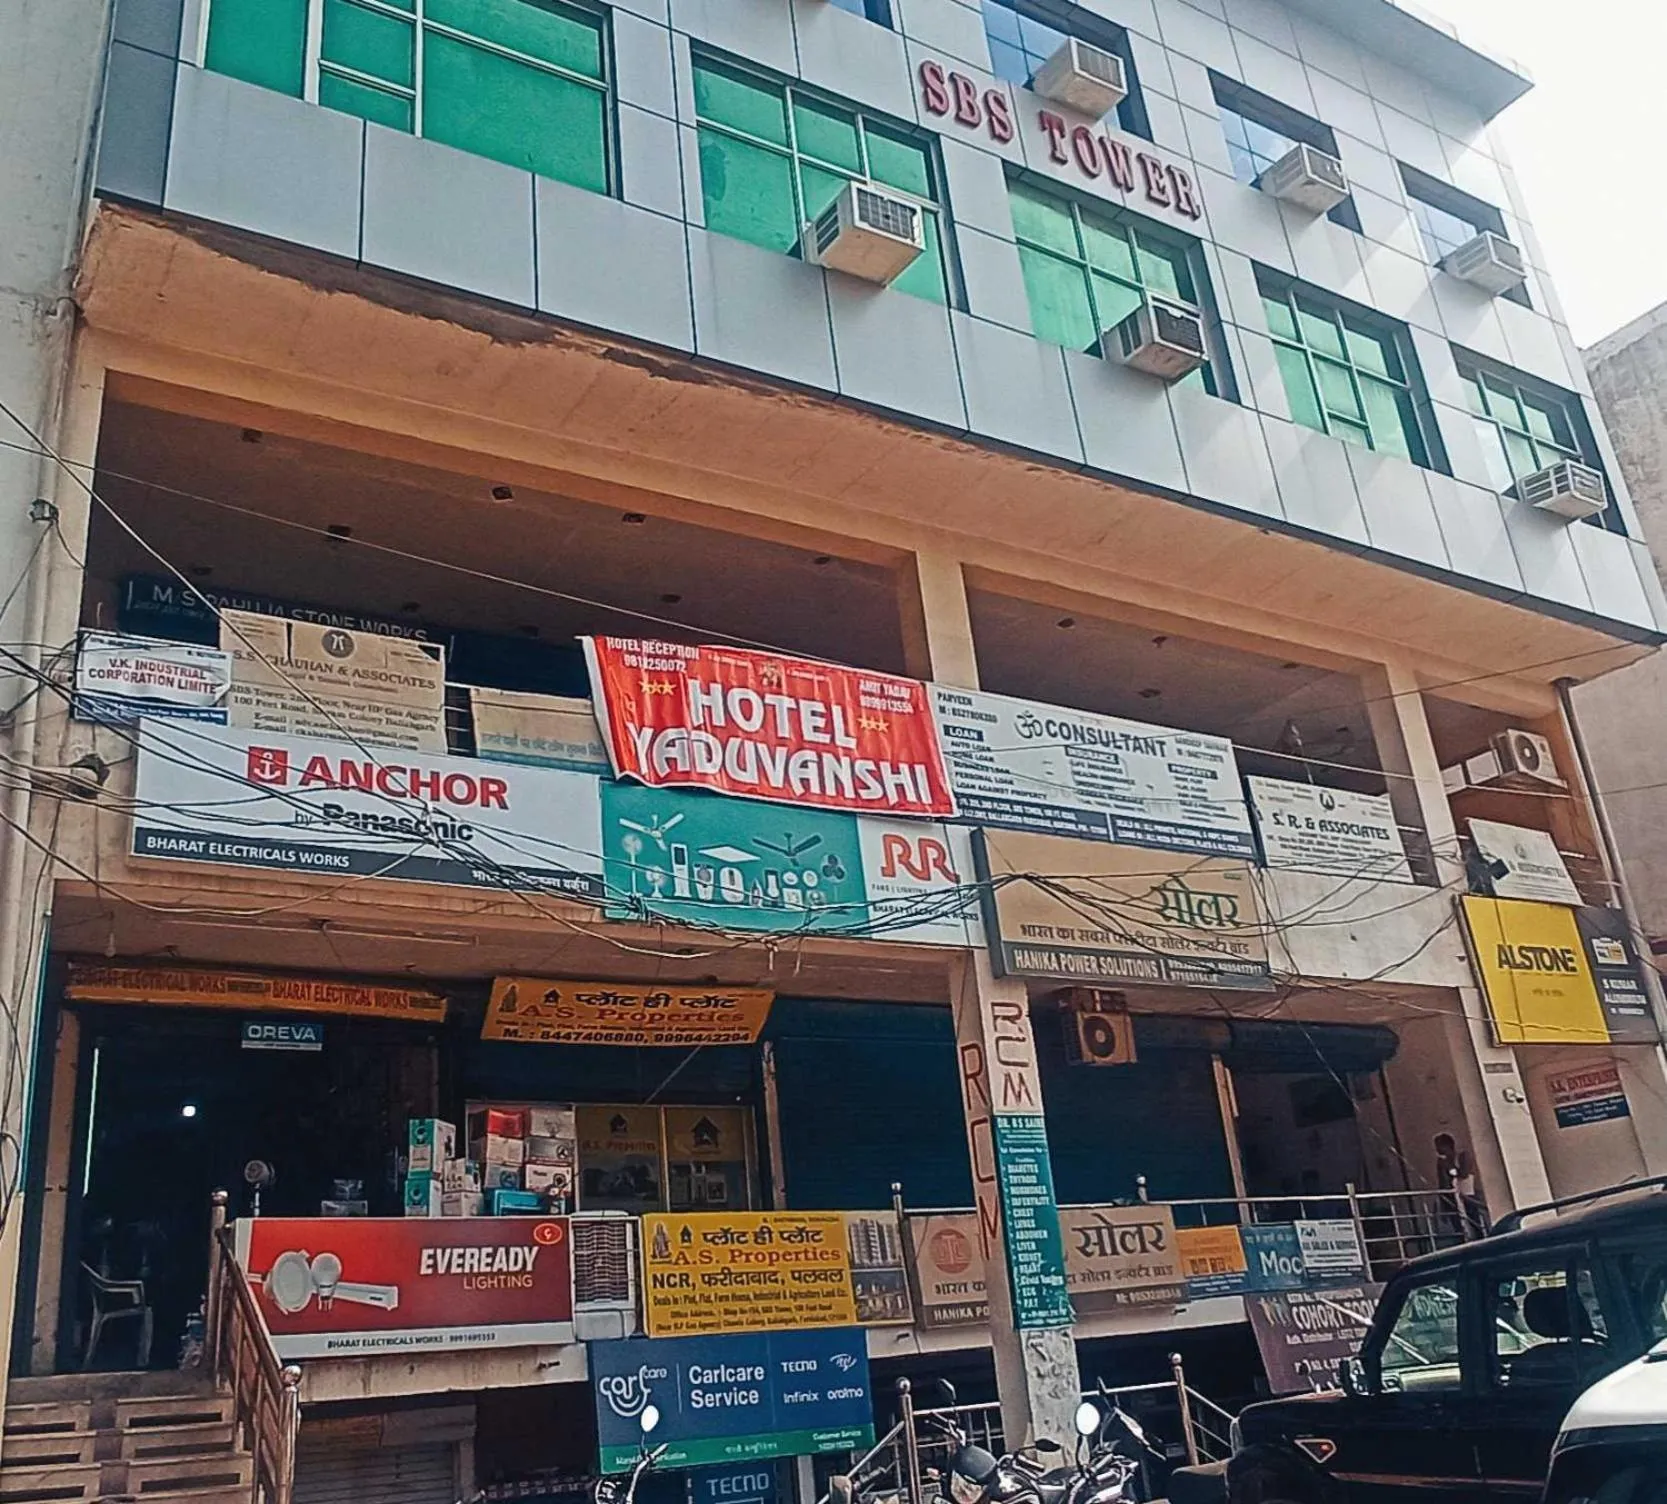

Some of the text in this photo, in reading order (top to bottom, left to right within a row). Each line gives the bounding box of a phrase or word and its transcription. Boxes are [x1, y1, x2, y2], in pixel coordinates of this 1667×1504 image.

[920, 60, 1201, 221] SBS TOWER
[606, 637, 641, 652] HOTEL
[642, 640, 700, 660] RECEPTION
[109, 658, 207, 680] V.K. INDUSTRIAL
[338, 665, 349, 676] &
[352, 668, 437, 690] ASSOCIATES
[89, 668, 220, 695] CORPORATION LIMITE
[687, 677, 858, 749] HOTEL
[949, 727, 979, 740] LOAN
[1044, 719, 1168, 758] CONSULTANT
[627, 722, 933, 806] YADUVANSHI
[298, 755, 510, 810] ANCHOR
[294, 803, 474, 841] by Panasonic
[1305, 817, 1316, 830] &
[1318, 819, 1390, 841] ASSOCIATES
[147, 836, 350, 868] BHARAT ELECTRICALS WORKS
[881, 833, 960, 884] RR
[1020, 923, 1055, 940] भारत
[1056, 926, 1076, 941] का
[1014, 949, 1059, 972] HANIKA
[1060, 955, 1099, 975] POWER
[1099, 957, 1159, 979] SOLUTIONS
[1496, 943, 1578, 973] ALSTONE
[271, 981, 312, 999] BHARAT
[313, 983, 373, 1007] ELECTRICAL
[374, 990, 410, 1009] WORKS
[596, 1007, 746, 1024] Properties
[247, 1024, 316, 1041] OREVA
[702, 1225, 824, 1246] प्लॉट ही प्लॉट
[1071, 1211, 1168, 1259] सोलर
[419, 1246, 539, 1276] EVEREADY
[671, 1248, 841, 1267] A.S. Properties
[463, 1273, 534, 1290] LIGHTING
[652, 1271, 697, 1291] NCR,
[790, 1267, 844, 1286] पलवल
[935, 1282, 968, 1296] भारत
[933, 1307, 975, 1321] HANIKA
[1292, 1304, 1345, 1331] COHORT
[327, 1335, 444, 1349] BHARAT ELECTRICALS WORKS
[689, 1364, 765, 1385] Carlcare
[781, 1360, 817, 1373] TECNO
[690, 1386, 760, 1409] Service
[783, 1389, 820, 1405] Infinix
[827, 1387, 864, 1401] oraimo
[706, 1472, 769, 1497] TECNO
